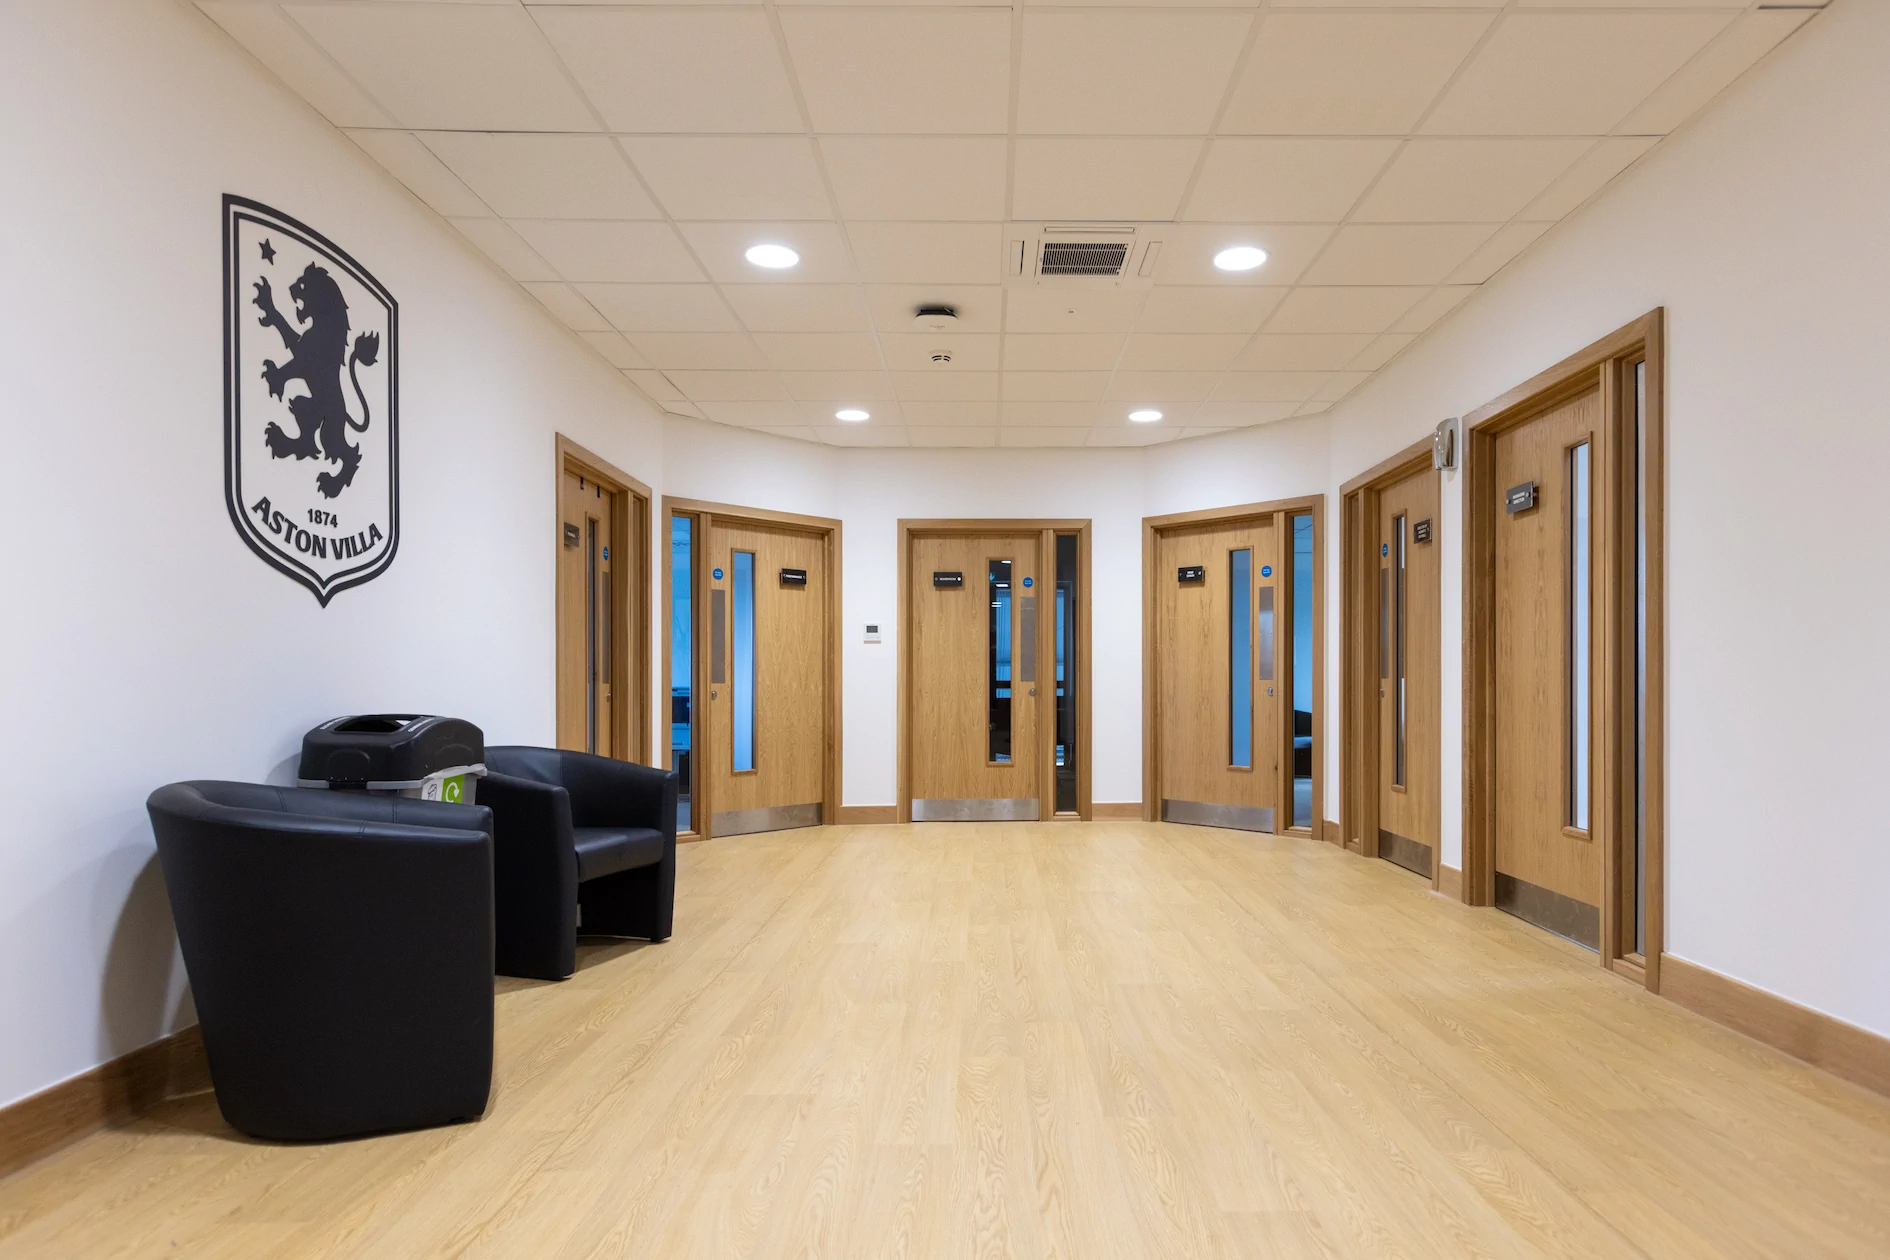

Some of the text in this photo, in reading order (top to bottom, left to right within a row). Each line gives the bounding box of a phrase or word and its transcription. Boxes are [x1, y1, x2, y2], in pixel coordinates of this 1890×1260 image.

[251, 496, 383, 560] ASTON VILLA
[307, 508, 338, 528] 1874
